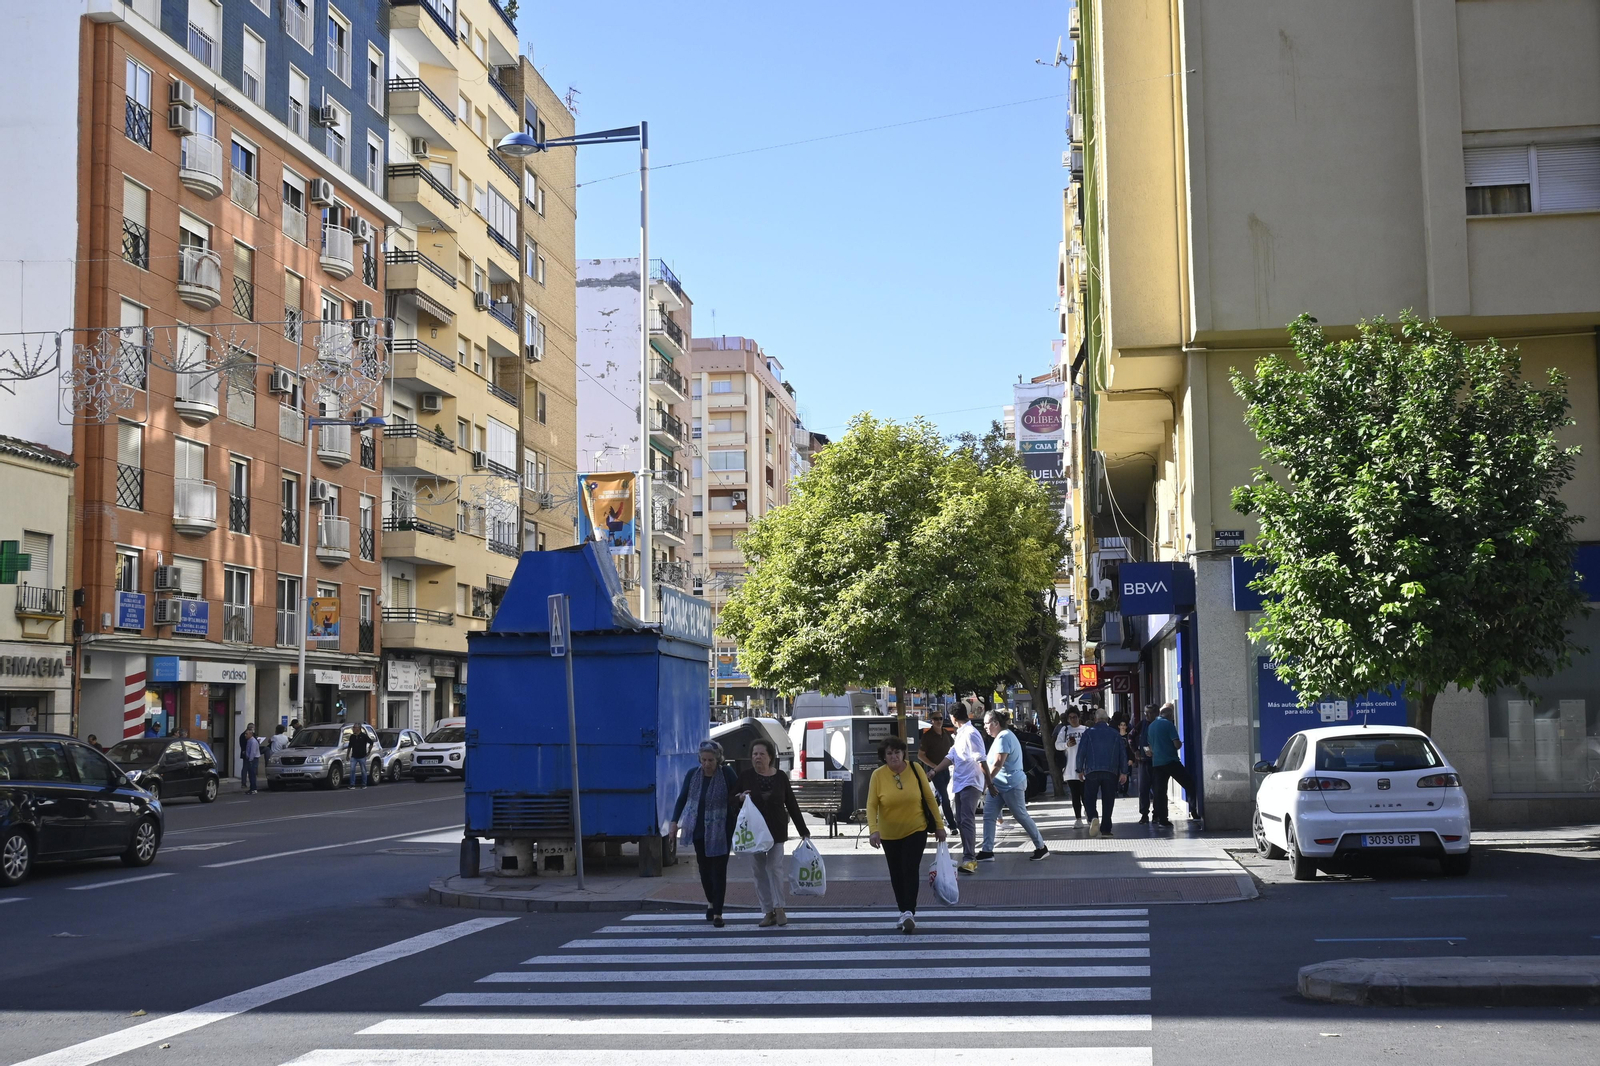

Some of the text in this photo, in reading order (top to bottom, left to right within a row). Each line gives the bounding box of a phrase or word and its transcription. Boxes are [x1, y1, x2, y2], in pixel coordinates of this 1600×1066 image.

[1124, 581, 1168, 594] BBVA
[0, 656, 64, 678] RMACIA
[222, 668, 246, 680] endesa
[341, 674, 351, 683] PAN
[1368, 835, 1416, 844] 3039 GBF
